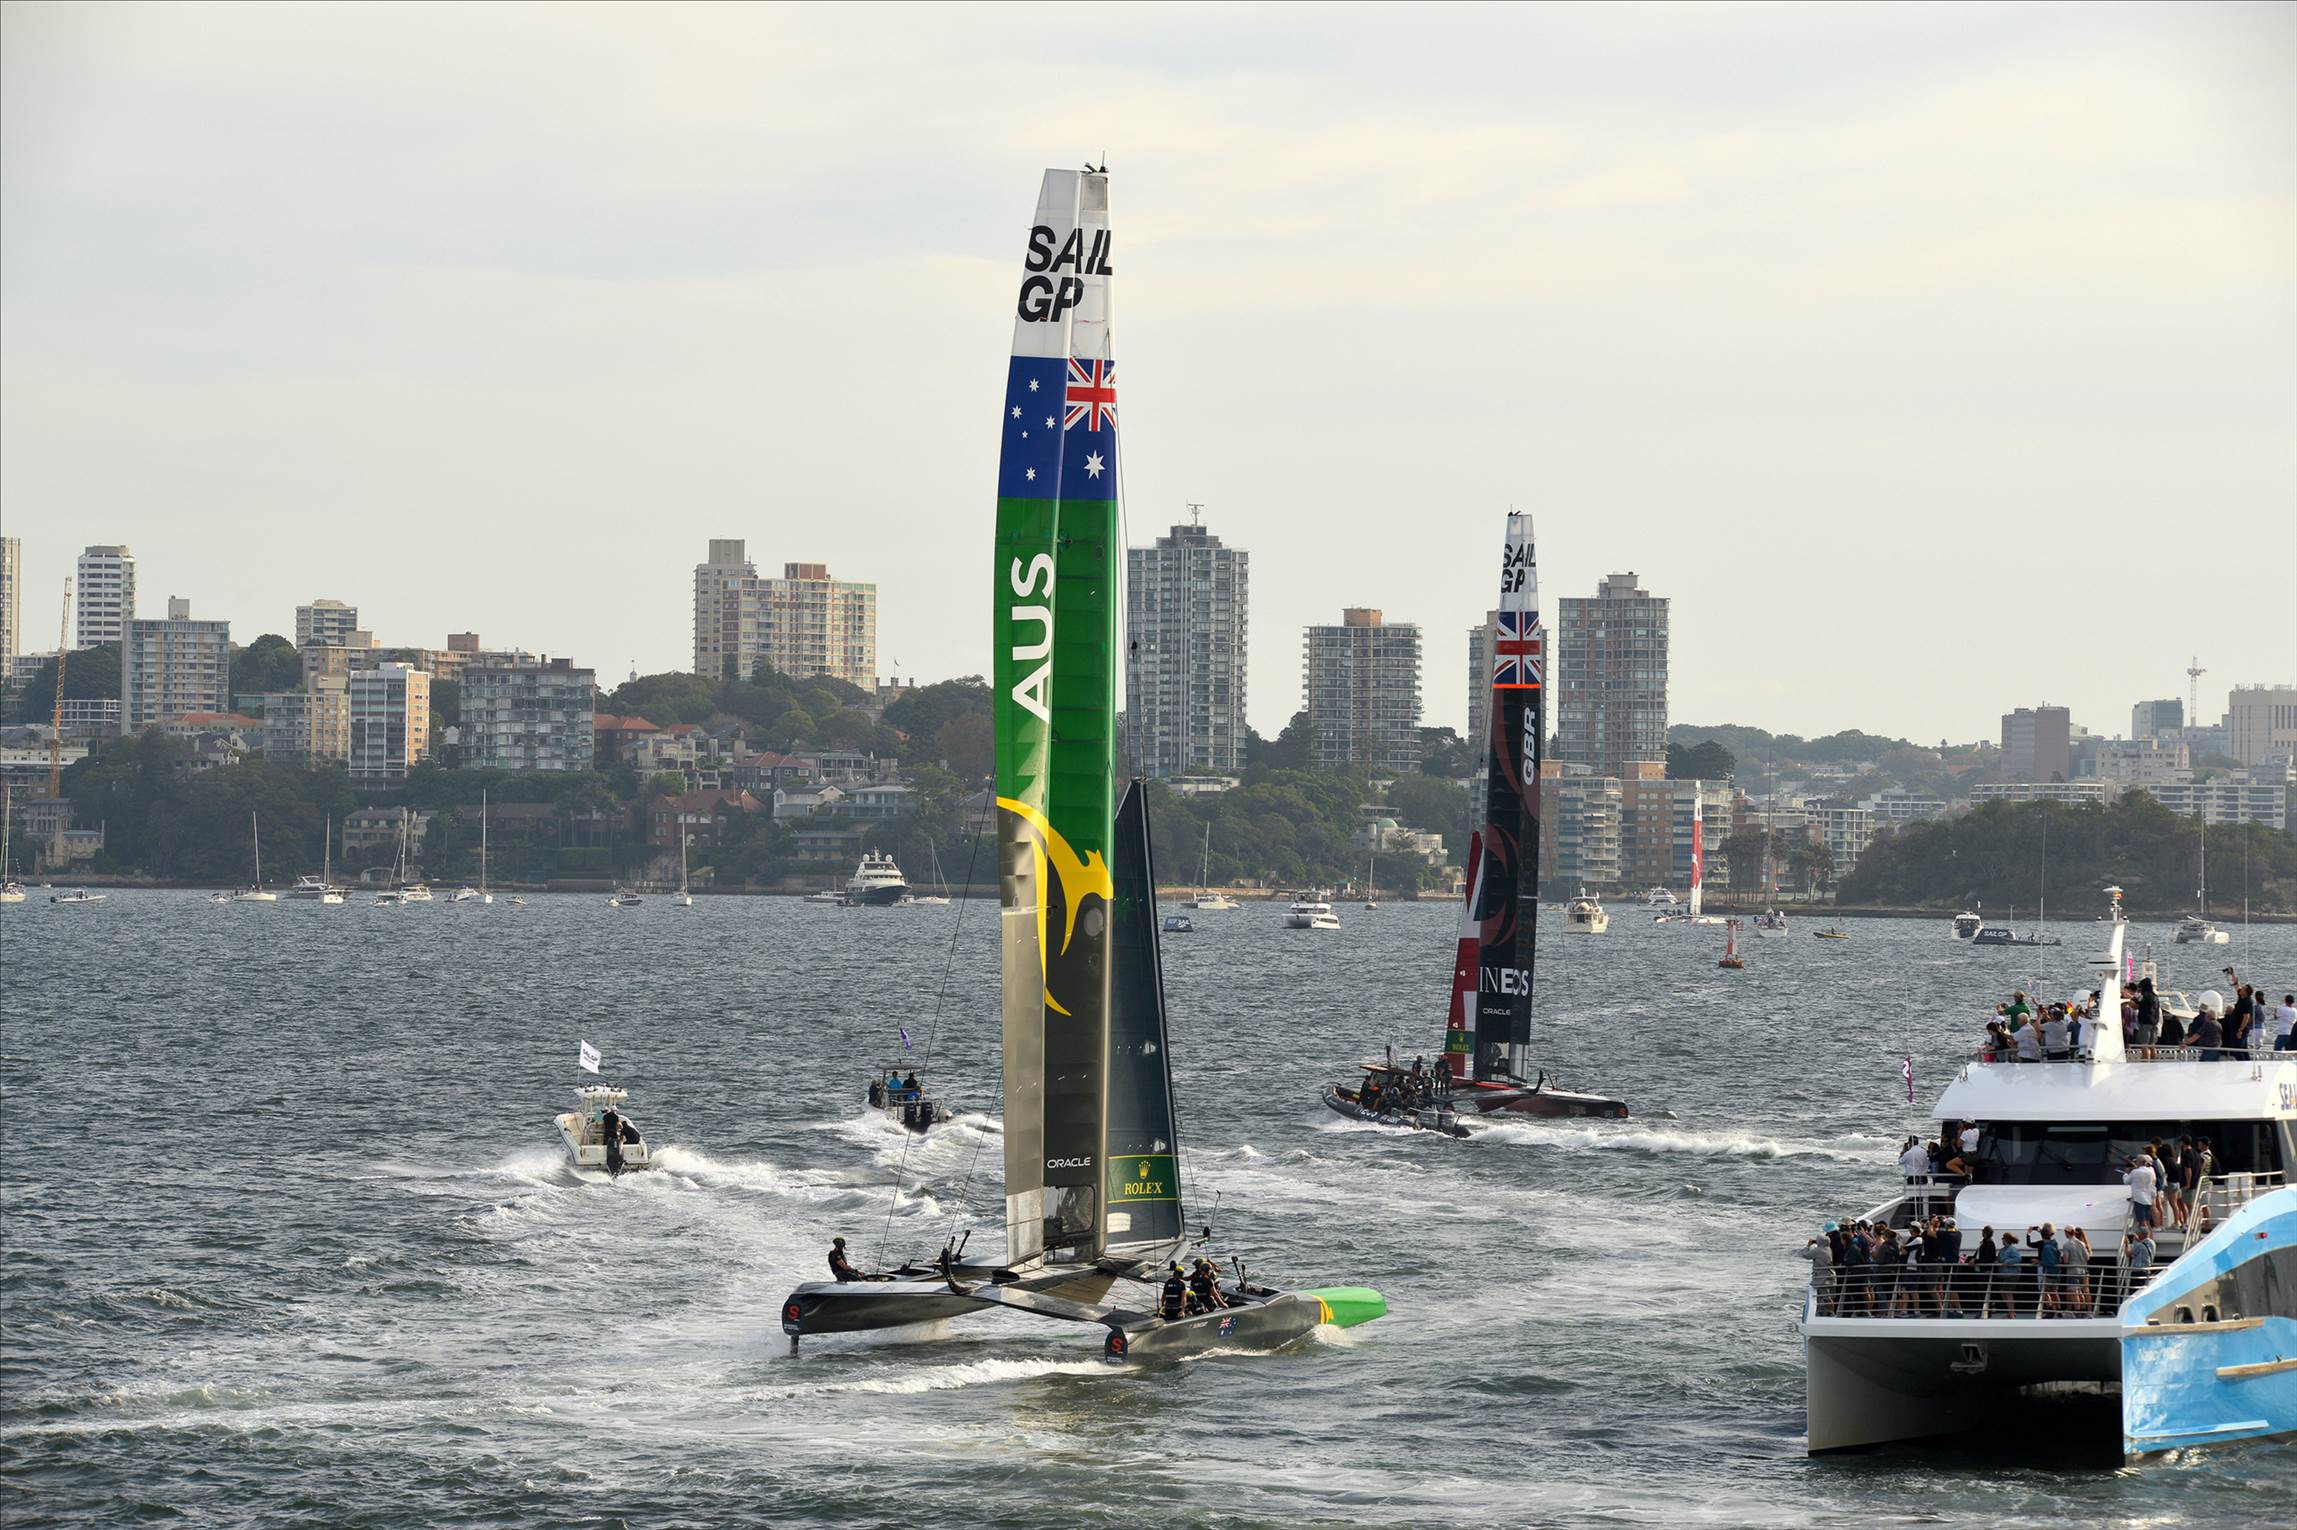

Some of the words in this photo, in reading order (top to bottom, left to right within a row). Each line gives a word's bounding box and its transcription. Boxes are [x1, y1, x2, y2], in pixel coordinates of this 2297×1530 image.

[1024, 225, 1113, 275] SAIL
[1018, 275, 1085, 323] GP
[1503, 543, 1536, 568] SAIL
[1501, 568, 1525, 593] GP
[1011, 553, 1055, 724] AUS
[1523, 707, 1536, 785] GBR
[1479, 966, 1529, 996] INEOS
[1482, 1007, 1512, 1016] ORACLE
[1046, 1156, 1092, 1169] ORACLE
[1124, 1182, 1163, 1195] ROLEX
